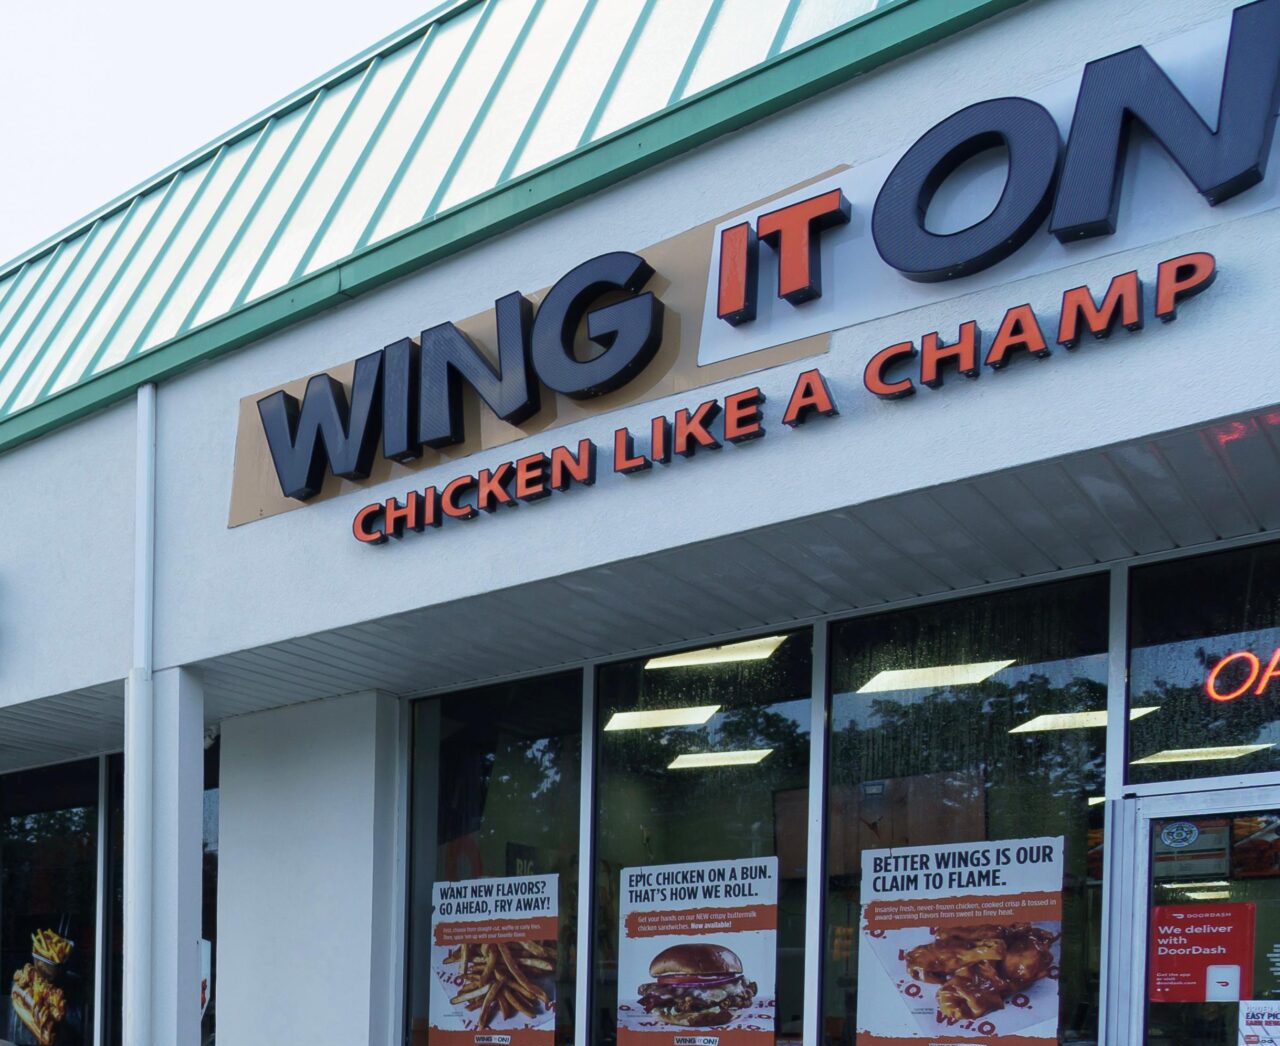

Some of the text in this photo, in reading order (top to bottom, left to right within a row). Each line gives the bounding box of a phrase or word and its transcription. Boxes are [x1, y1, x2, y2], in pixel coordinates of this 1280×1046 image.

[262, 0, 1280, 500] WING IT ON
[353, 251, 1218, 545] CHICKEN LIKE A CHAMP
[873, 845, 1054, 874] BETTER WINGS IS OUR
[628, 865, 771, 888] EPIC CHICKEN ON A BUN.
[873, 869, 1007, 893] CLAIM TO FLAME.
[440, 881, 547, 900] WANT NEW FLAVORS?
[628, 883, 758, 903] THAT'S HOW WE ROLL.
[440, 897, 551, 916] GO AHEAD, FRY AWAY!
[1005, 900, 1020, 908] crisp
[727, 911, 756, 919] buttermilk
[1158, 924, 1233, 934] We deliver
[1158, 936, 1187, 945] with
[1158, 945, 1226, 955] DoorDash
[1246, 1012, 1265, 1020] EASY
[703, 1037, 717, 1045] ON!
